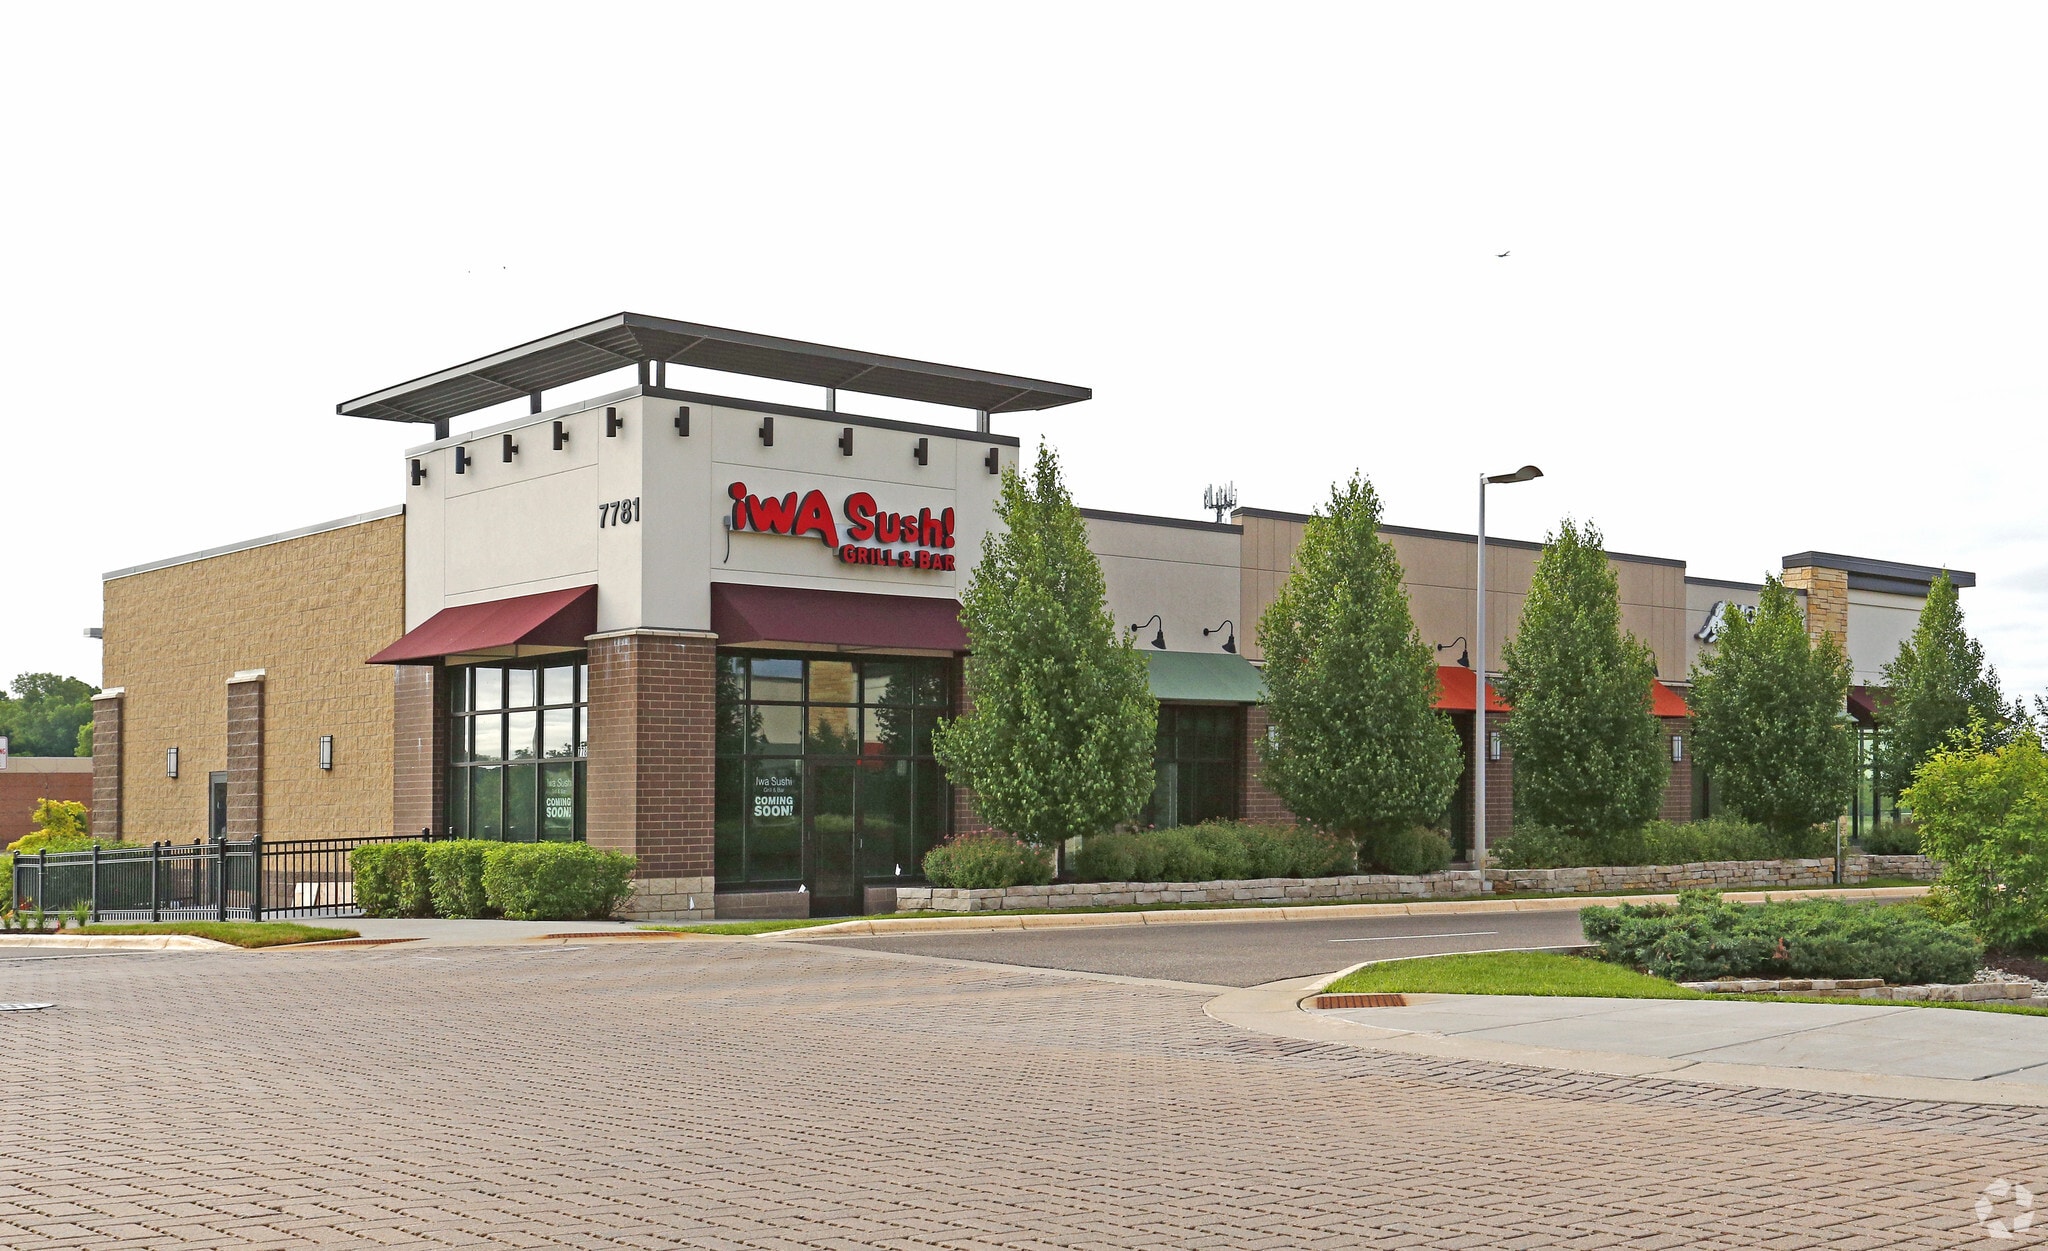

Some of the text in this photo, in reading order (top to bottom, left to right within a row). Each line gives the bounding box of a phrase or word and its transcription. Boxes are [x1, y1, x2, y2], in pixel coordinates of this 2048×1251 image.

[599, 496, 640, 528] 7781
[839, 543, 956, 571] GRILL & BAR
[755, 776, 793, 786] Iwa Sushi
[546, 797, 572, 807] COMING
[754, 796, 794, 805] COMING
[546, 806, 572, 818] SOON!
[754, 805, 794, 817] SOON!
